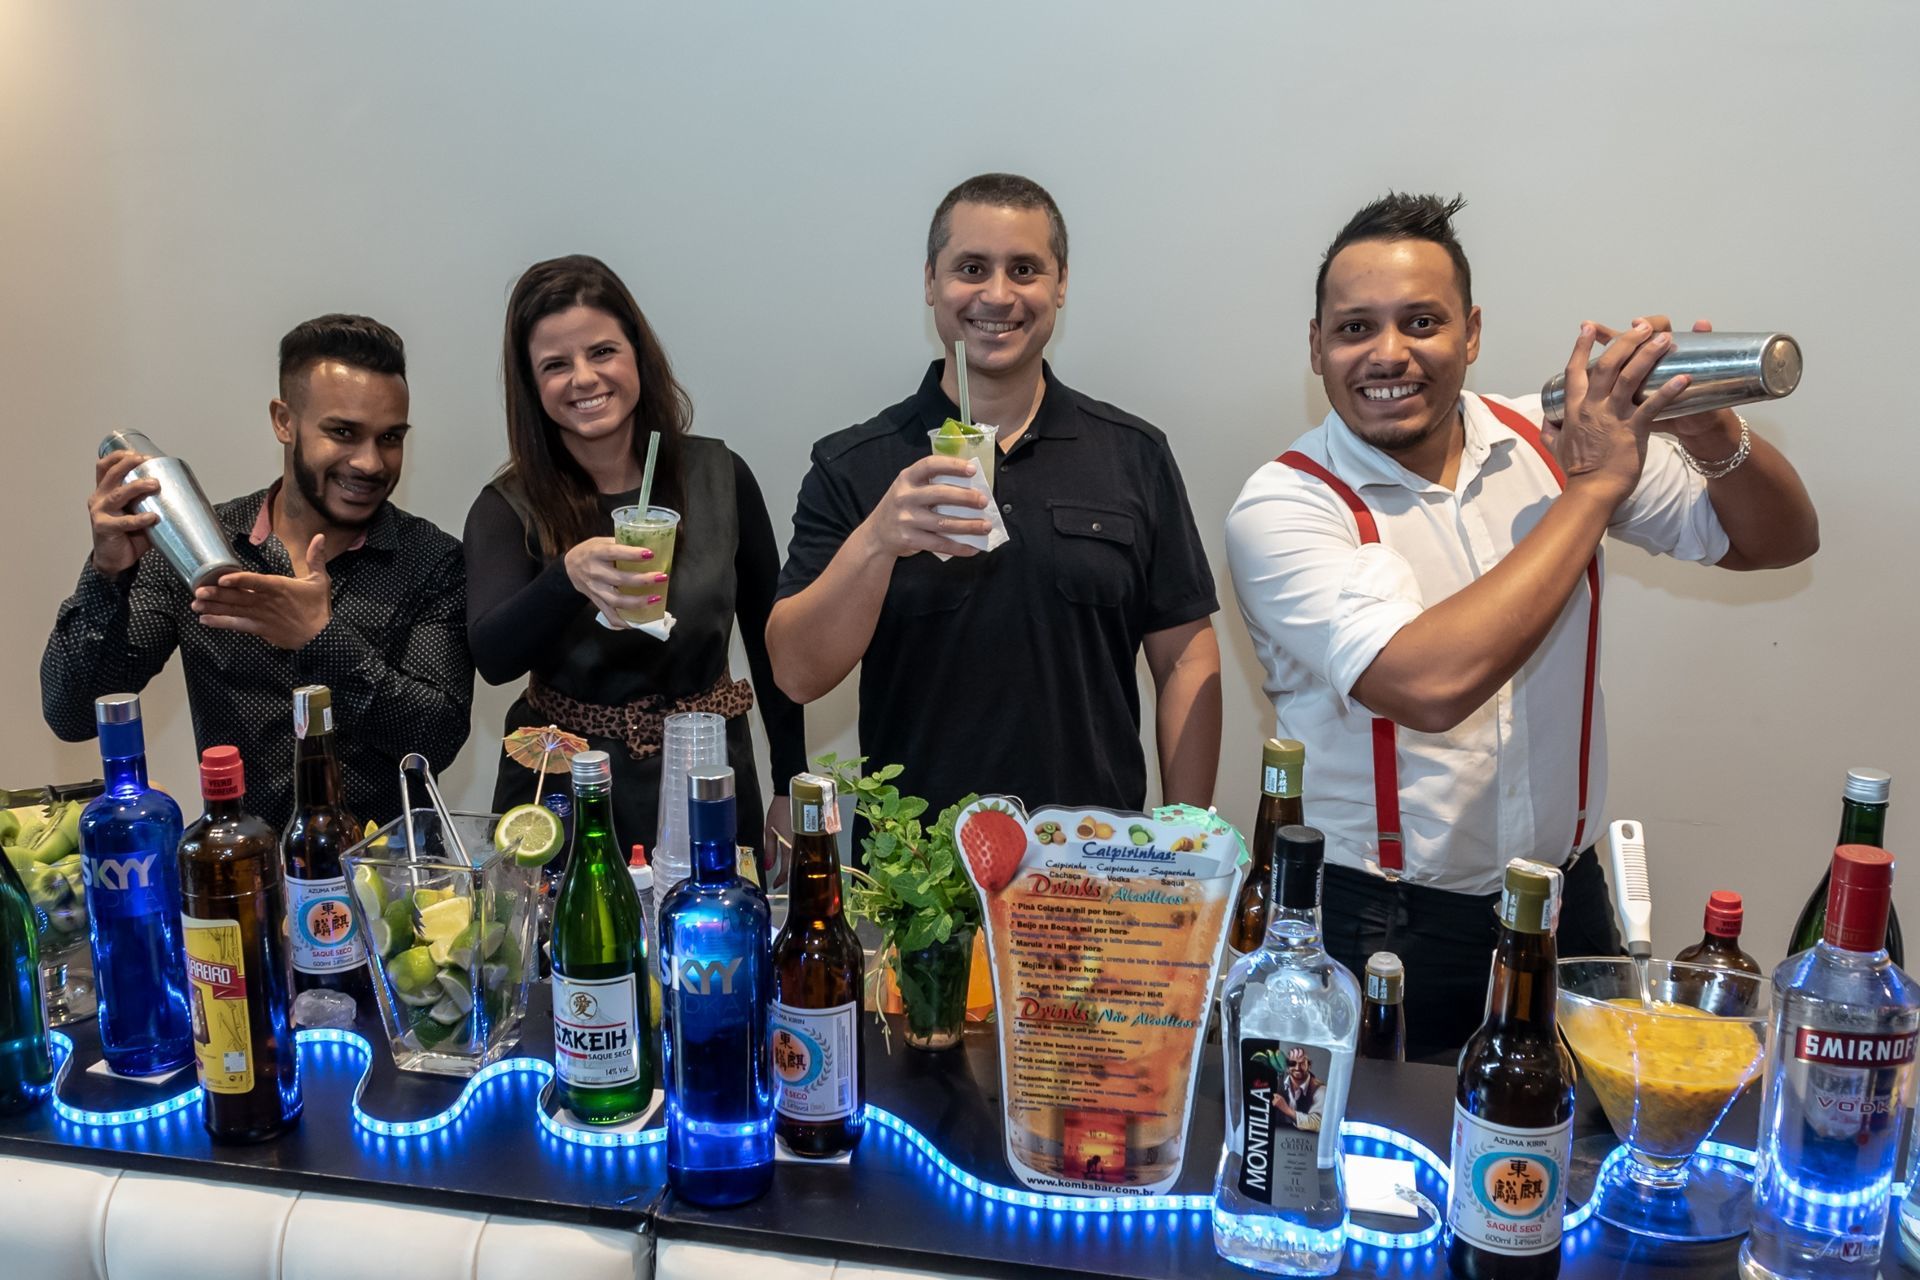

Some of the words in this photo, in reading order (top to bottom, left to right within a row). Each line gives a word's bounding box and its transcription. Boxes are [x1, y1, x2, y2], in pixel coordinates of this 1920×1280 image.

[1083, 842, 1176, 862] Caipirinhas:
[80, 853, 158, 890] SKYY
[1046, 860, 1086, 871] Caipirinha
[1050, 871, 1081, 880] Cachaça
[1107, 875, 1130, 883] Vodka
[1161, 878, 1185, 887] Saquê
[1027, 873, 1101, 899] Drinks
[1037, 904, 1064, 912] Colada
[1073, 906, 1085, 914] mil
[1017, 921, 1037, 929] Beijo
[1051, 923, 1071, 931] Boca
[1016, 940, 1043, 948] Marula
[336, 947, 352, 955] SECO
[186, 958, 231, 984] RREIRO
[661, 945, 743, 995] SKYY
[1054, 963, 1067, 971] mil
[1066, 984, 1089, 993] beach
[1015, 997, 1090, 1022] Drinks
[1097, 1008, 1128, 1023] Não
[555, 1022, 626, 1051] SAKEIH
[1055, 1042, 1075, 1050] beach
[614, 1049, 632, 1058] SECO
[605, 1067, 617, 1076] 14%
[790, 1090, 807, 1100] SECO
[1817, 1095, 1891, 1114] VODK
[1246, 1088, 1271, 1191] MONTILLA
[1493, 1136, 1524, 1147] AZUMA
[1527, 1140, 1547, 1148] KIRIN
[1507, 1160, 1530, 1178] 東
[1026, 1177, 1155, 1196] www.kombsbar.com.br
[1486, 1220, 1518, 1233] SAQUÊ
[1520, 1224, 1542, 1233] SECO
[1485, 1233, 1511, 1244] 600ml
